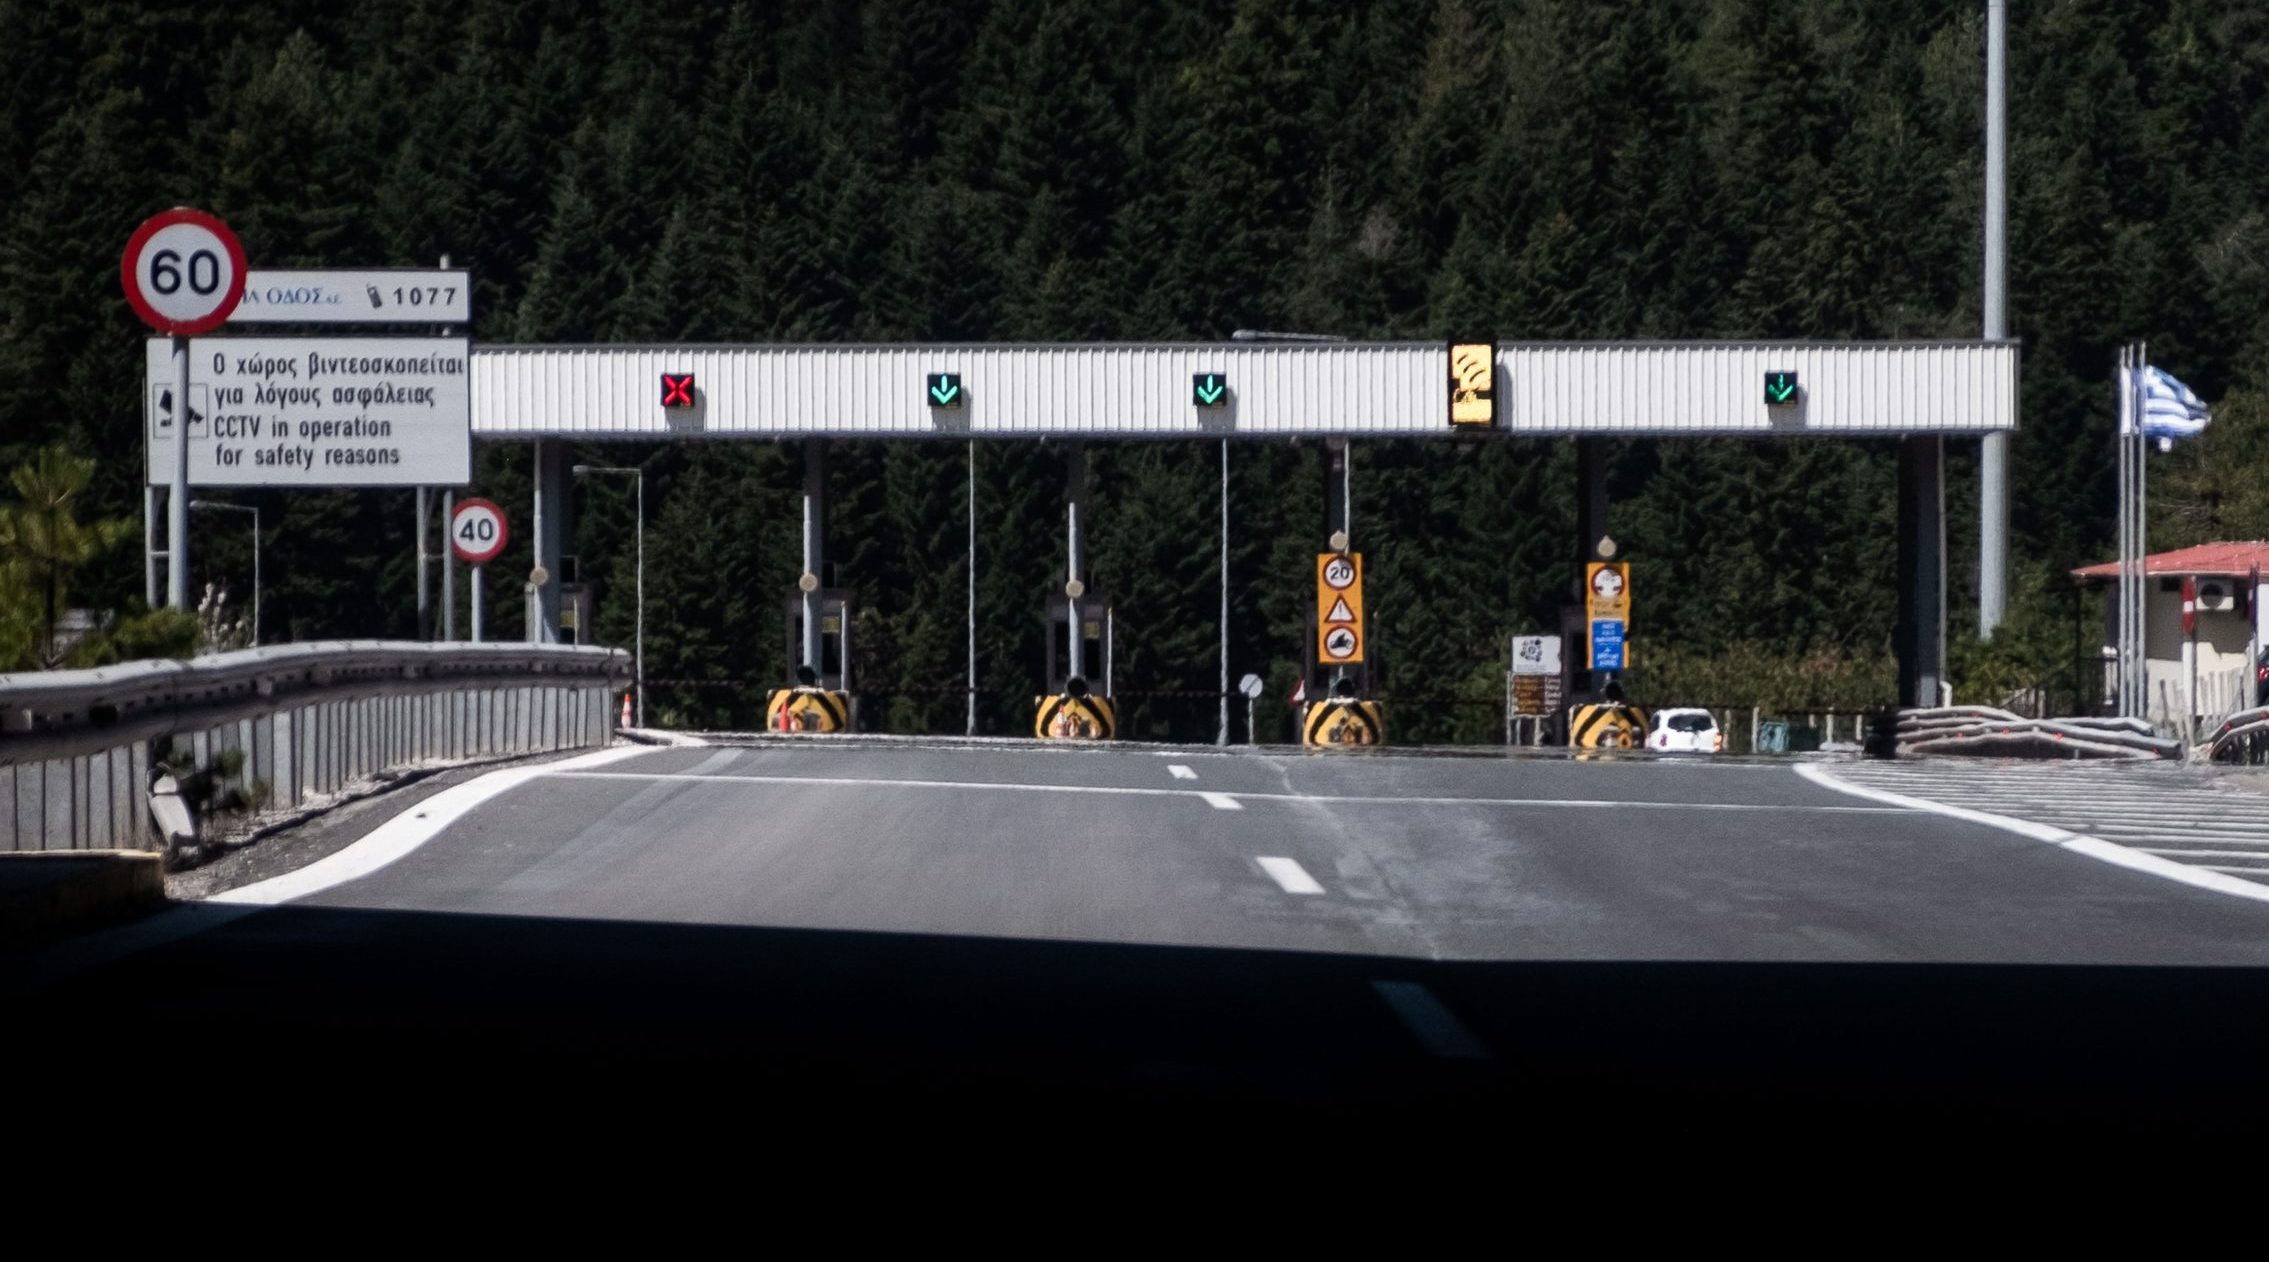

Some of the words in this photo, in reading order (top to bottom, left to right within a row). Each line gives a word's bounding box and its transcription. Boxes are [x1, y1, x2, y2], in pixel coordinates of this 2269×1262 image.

[150, 248, 219, 296] 60
[265, 286, 322, 304] ΟΔΟΣ
[393, 287, 457, 306] 1077
[213, 352, 225, 376] Ο
[236, 352, 297, 380] χώρος
[308, 351, 464, 380] βιντεοσκοπείται
[213, 386, 243, 410] για
[254, 381, 321, 410] λόγους
[332, 381, 434, 410] ασφάλειας
[213, 415, 261, 438] CCTV
[271, 415, 289, 438] in
[299, 415, 391, 442] operation
[215, 443, 243, 466] for
[254, 443, 314, 470] safety
[324, 446, 400, 465] reasons
[459, 518, 493, 541] 40
[1329, 566, 1350, 580] 20
